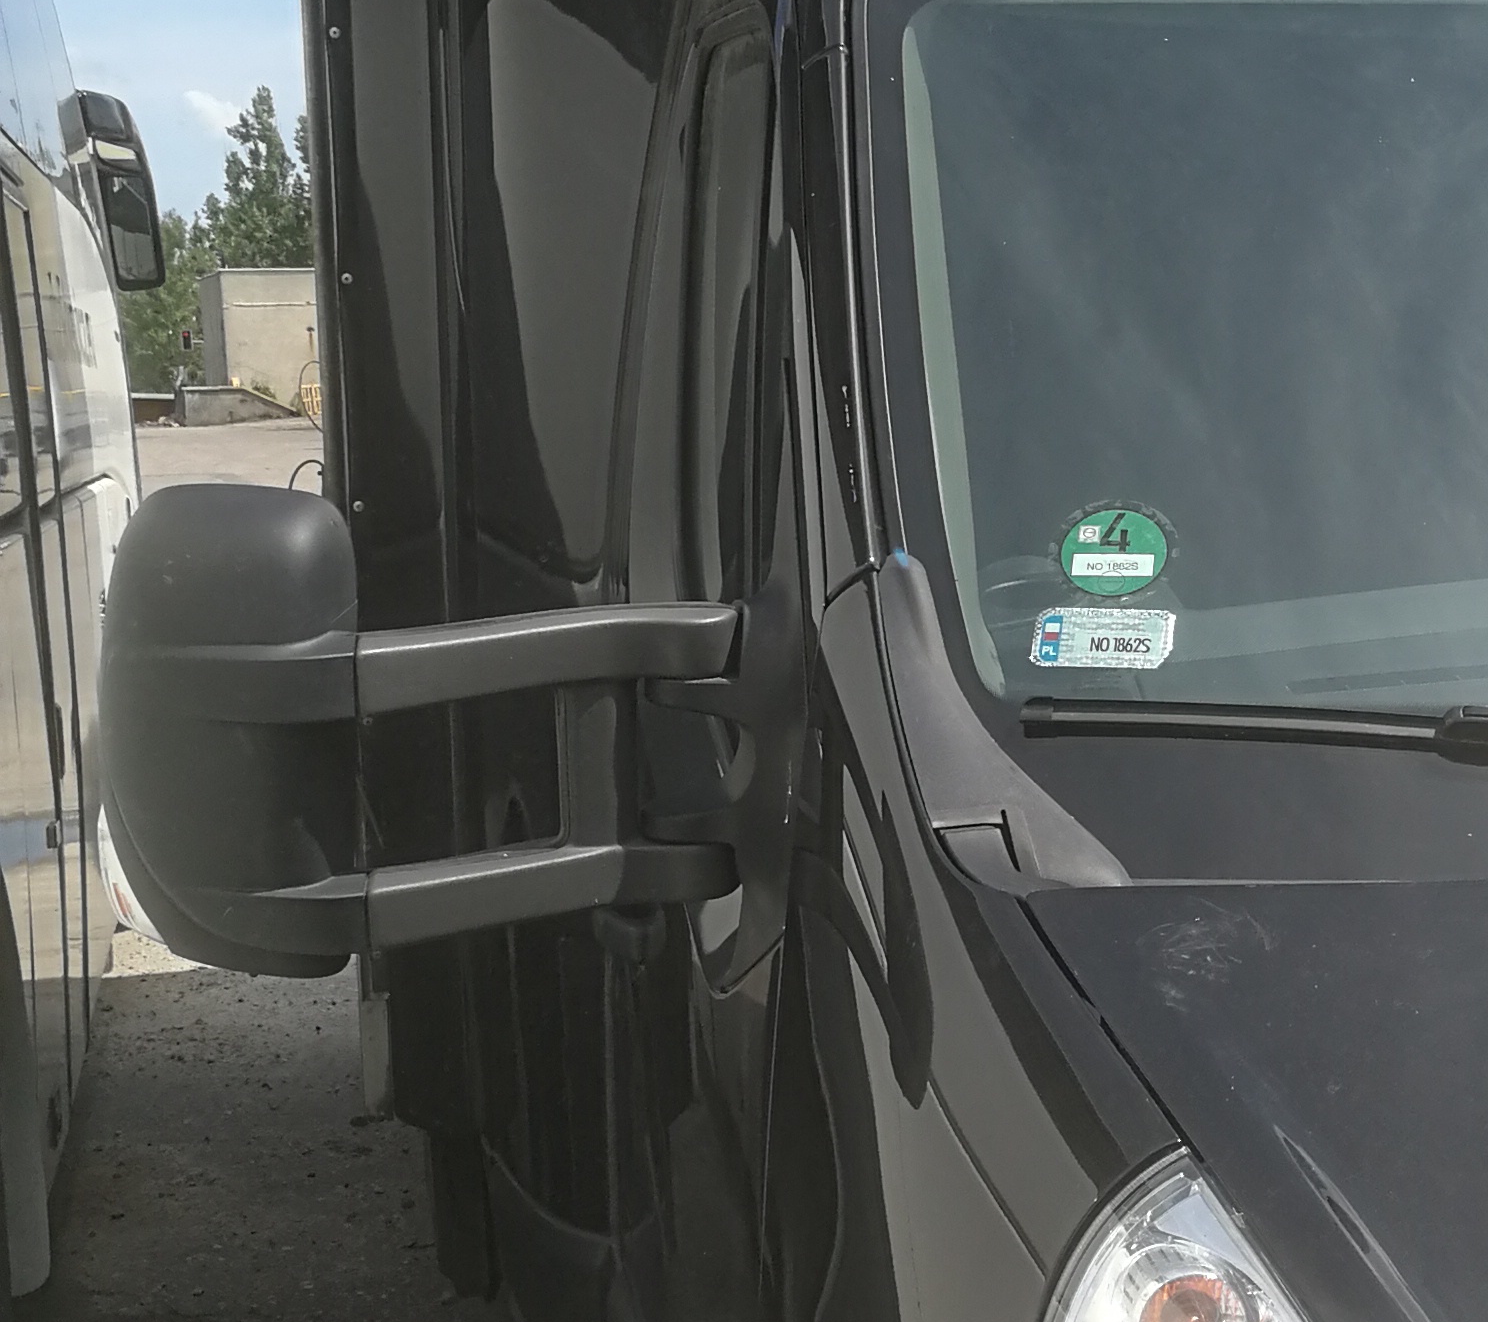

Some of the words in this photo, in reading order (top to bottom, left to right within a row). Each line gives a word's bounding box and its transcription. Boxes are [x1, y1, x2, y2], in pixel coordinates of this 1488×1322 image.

[1099, 512, 1131, 553] 4
[1086, 562, 1103, 571] NO
[1041, 645, 1057, 657] PL
[1089, 637, 1110, 653] NO
[1113, 637, 1152, 654] 1862S
